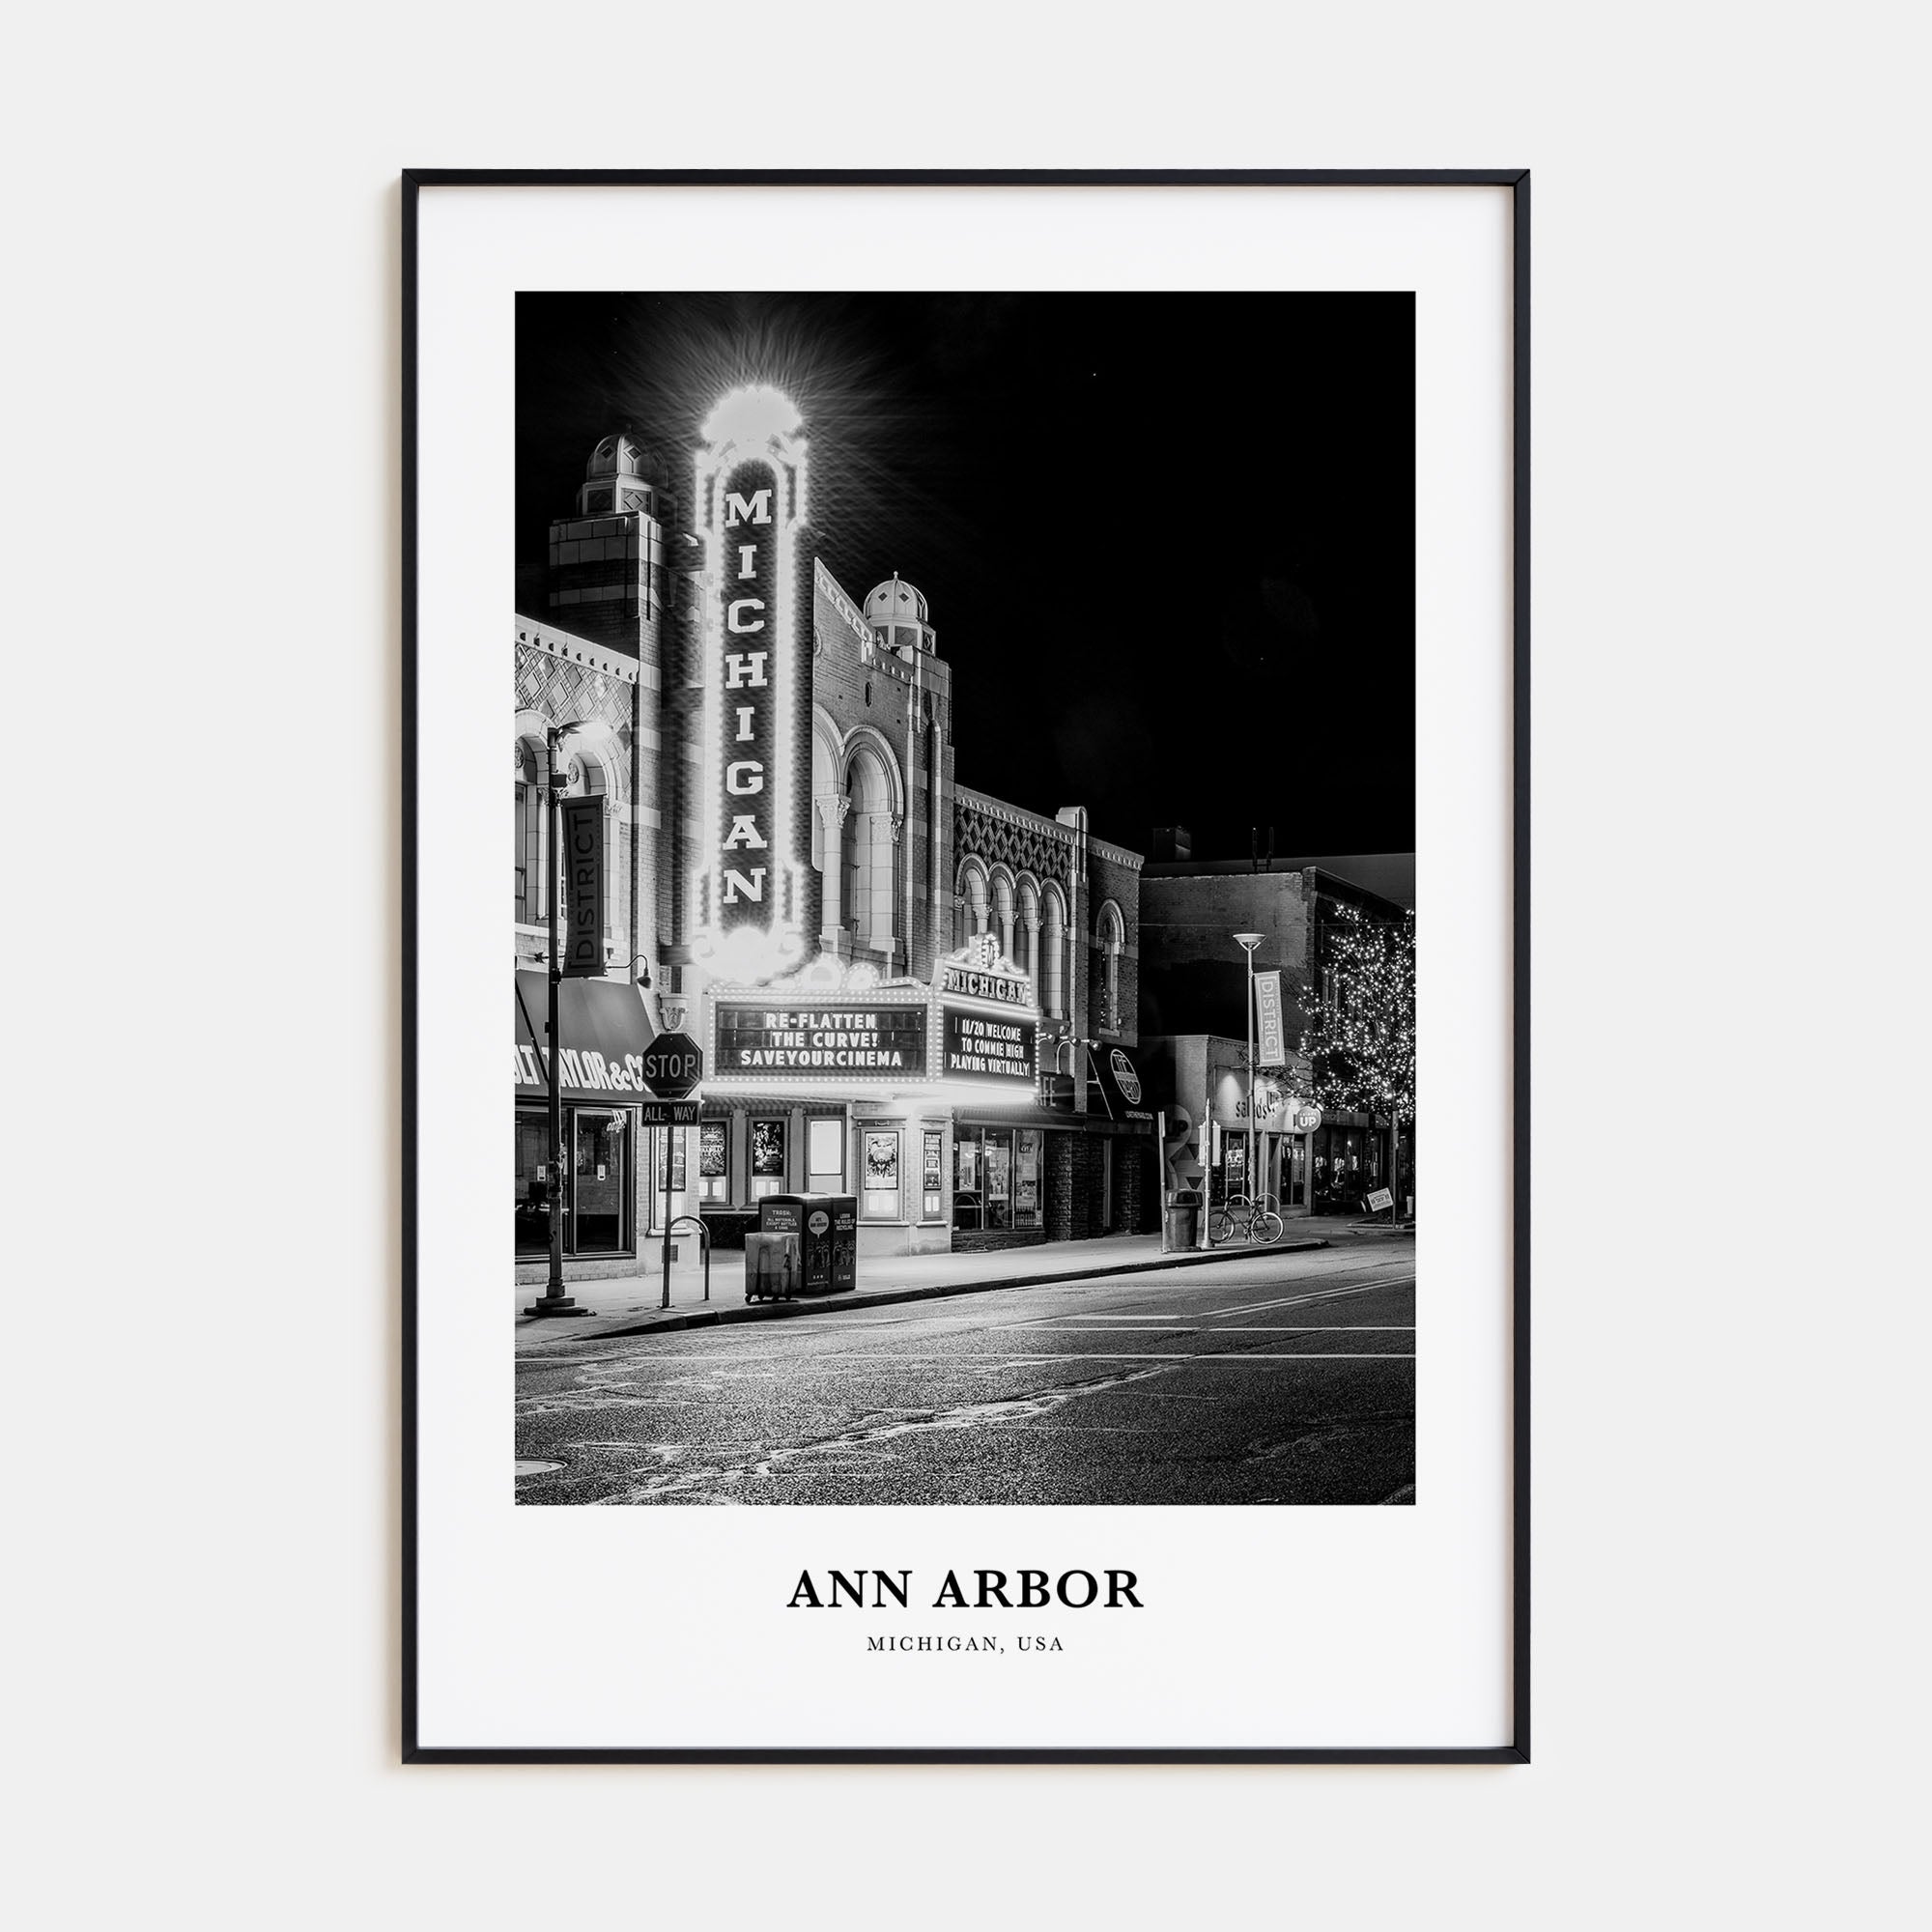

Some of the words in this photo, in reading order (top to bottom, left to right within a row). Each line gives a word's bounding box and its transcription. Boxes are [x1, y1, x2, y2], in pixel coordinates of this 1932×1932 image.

[722, 488, 772, 903] MICHIGAN
[574, 813, 595, 960] DISTRICT
[947, 968, 1026, 1004] MICHIGAN
[766, 1012, 877, 1029] RE-FLATTEN
[1262, 980, 1279, 1058] DISTRICT
[773, 1032, 805, 1047] THE
[812, 1032, 878, 1048] CURVE!
[985, 1022, 1021, 1042] WELCOME
[741, 1050, 902, 1066] SAVEYOURCINEMA
[961, 1037, 973, 1053] TO
[1006, 1042, 1024, 1060] HIGH
[645, 1053, 696, 1078] STOP
[951, 1052, 986, 1072] PLAYING
[987, 1058, 1031, 1077] VIRTUALLY
[643, 1106, 666, 1122] ALL
[673, 1106, 696, 1122] WAY
[1299, 1116, 1317, 1127] UP
[786, 1570, 913, 1608] ANN
[932, 1570, 1145, 1608] ARBOR
[867, 1636, 1006, 1654] MICHIGAN,
[1017, 1636, 1065, 1652] USA
